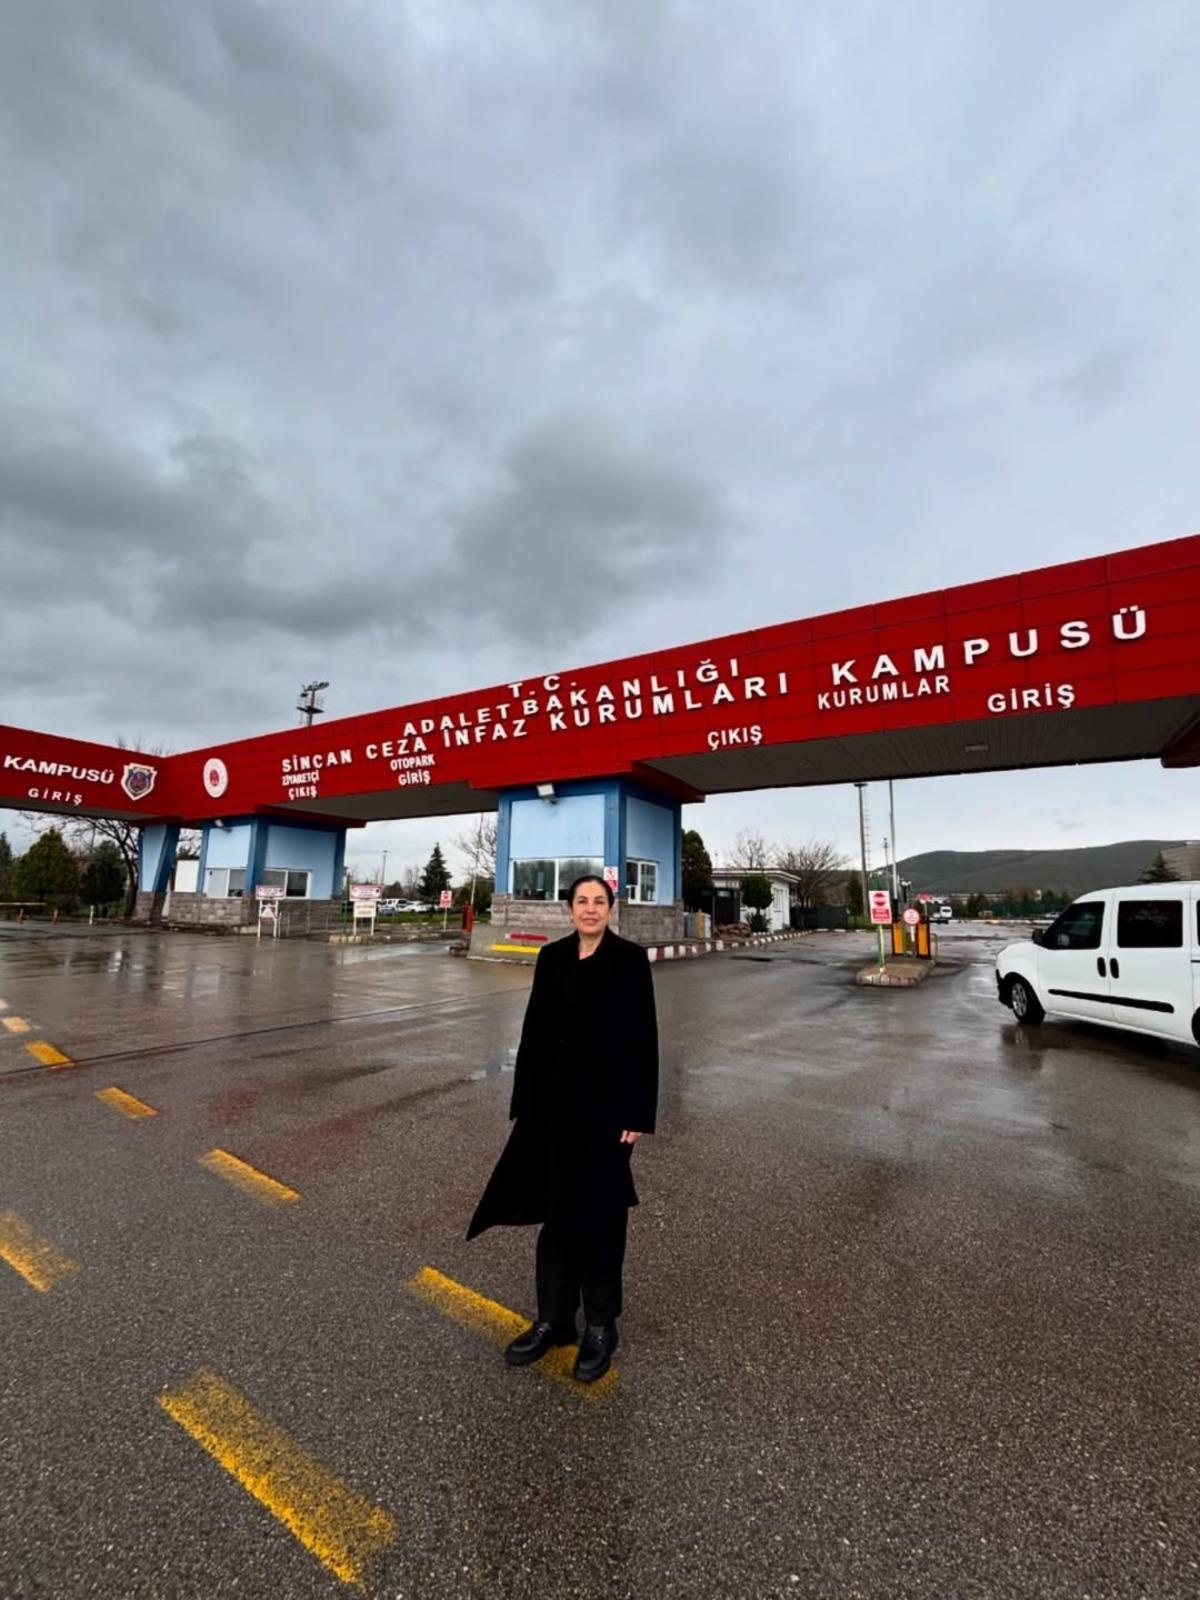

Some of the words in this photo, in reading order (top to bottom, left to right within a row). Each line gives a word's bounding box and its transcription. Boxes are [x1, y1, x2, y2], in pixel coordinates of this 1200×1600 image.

[282, 749, 352, 773] SİNCAN
[366, 738, 427, 759] CEZA
[444, 719, 527, 747] İNFAZ
[551, 672, 788, 731] KURUMLARI
[832, 605, 1147, 685] KAMPUSÜ
[403, 705, 510, 736] ADALET
[523, 658, 739, 715] BAKANLIĞI
[817, 675, 950, 710] KURUMLAR
[987, 684, 1076, 713] GİRİŞ
[707, 725, 763, 750] ÇIKIŞ
[4, 755, 115, 784] KAMPUSÜ
[390, 754, 436, 771] OTOPARK
[398, 770, 431, 786] GİRİŞ
[28, 787, 83, 806] GİRİŞ
[288, 785, 318, 801] ÇIKIŞ
